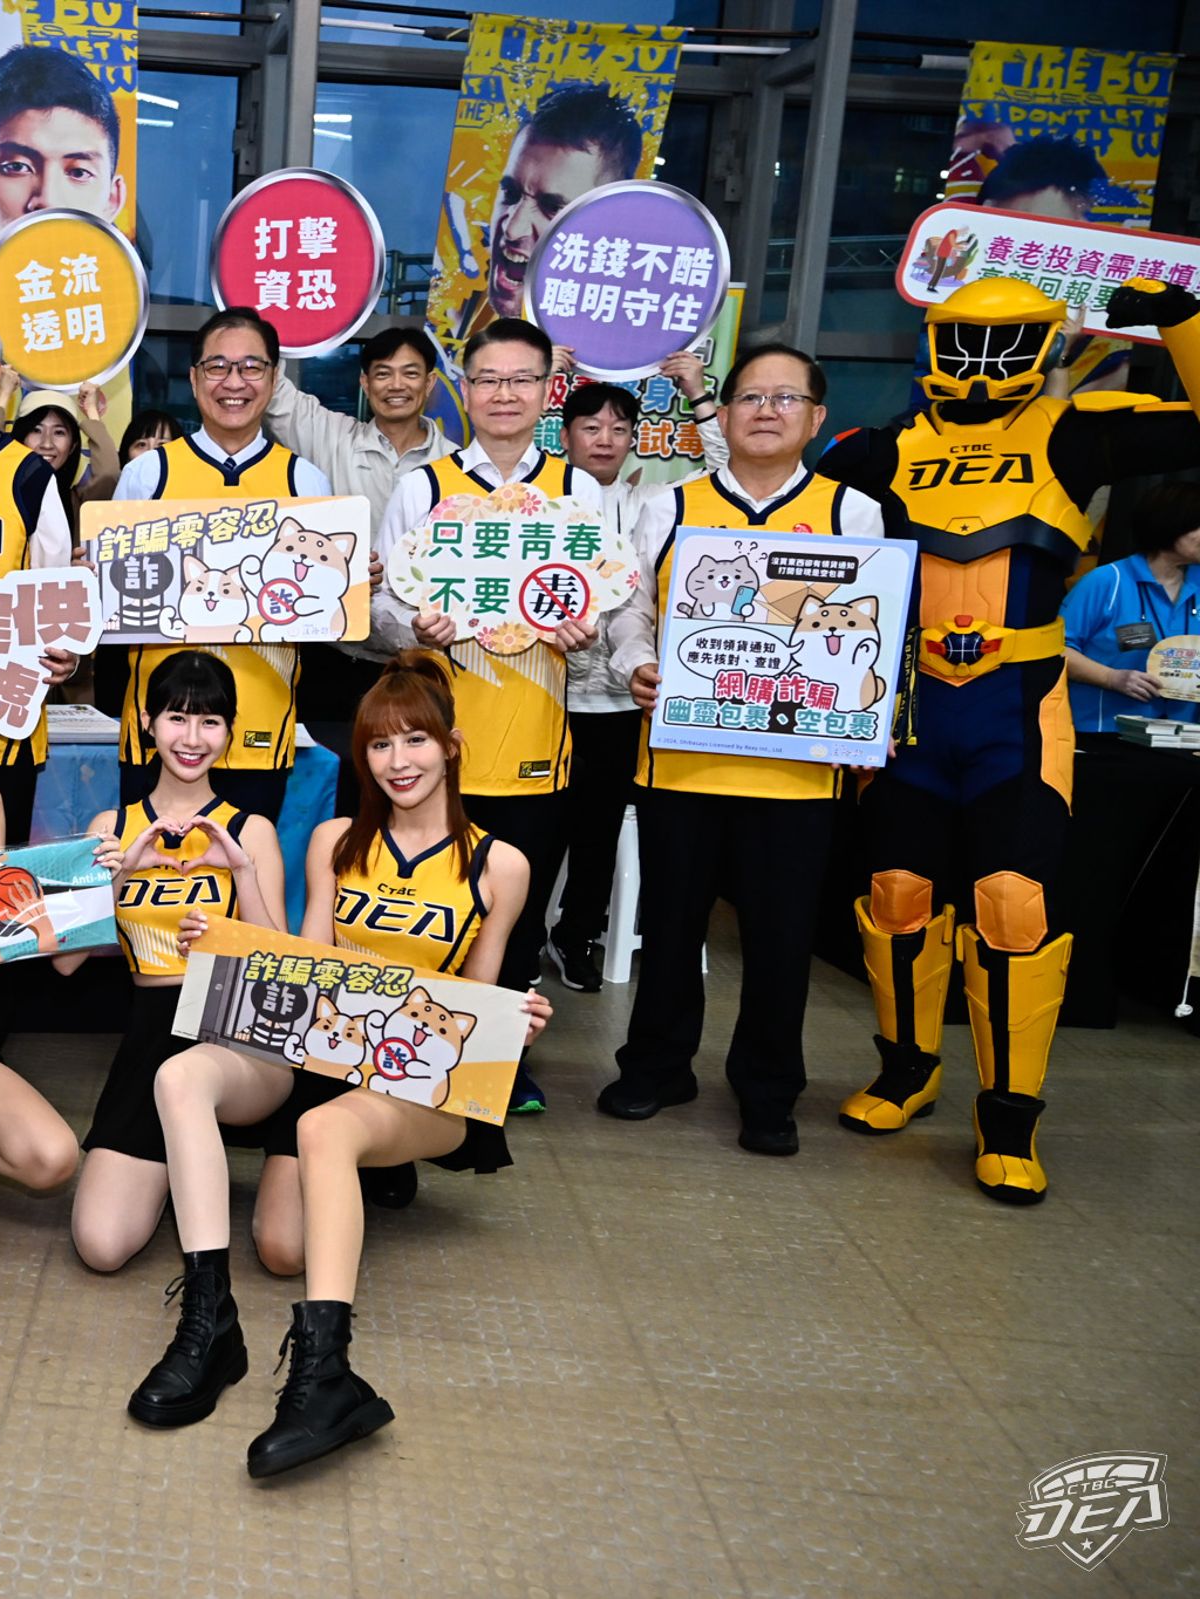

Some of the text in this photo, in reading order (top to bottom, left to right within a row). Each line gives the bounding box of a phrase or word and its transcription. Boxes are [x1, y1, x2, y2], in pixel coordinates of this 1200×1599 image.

[254, 217, 338, 260] 打擊
[549, 232, 715, 288] 洗錢不酷
[15, 253, 102, 304] 金流
[986, 236, 1200, 290] 養老投資需謹慎
[254, 269, 337, 312] 資恐
[539, 278, 703, 334] 聰明守住
[21, 304, 107, 354] 透明
[950, 443, 993, 454] CTBC
[908, 453, 1035, 491] DEA
[99, 500, 278, 563] 詐騙零容忍
[428, 521, 602, 561] 只要青春
[125, 555, 159, 590] 詐
[428, 574, 579, 622] 不要 毒
[695, 636, 776, 653] 收到領貨通知
[715, 670, 837, 711] 網購詐騙
[666, 698, 876, 738] 幽靈包裹、空包裹
[119, 874, 222, 908] DEA
[377, 883, 417, 896] CTBC
[335, 887, 455, 944] DEA
[244, 950, 414, 997] 詐騙零容忍
[264, 982, 297, 1016] 詐
